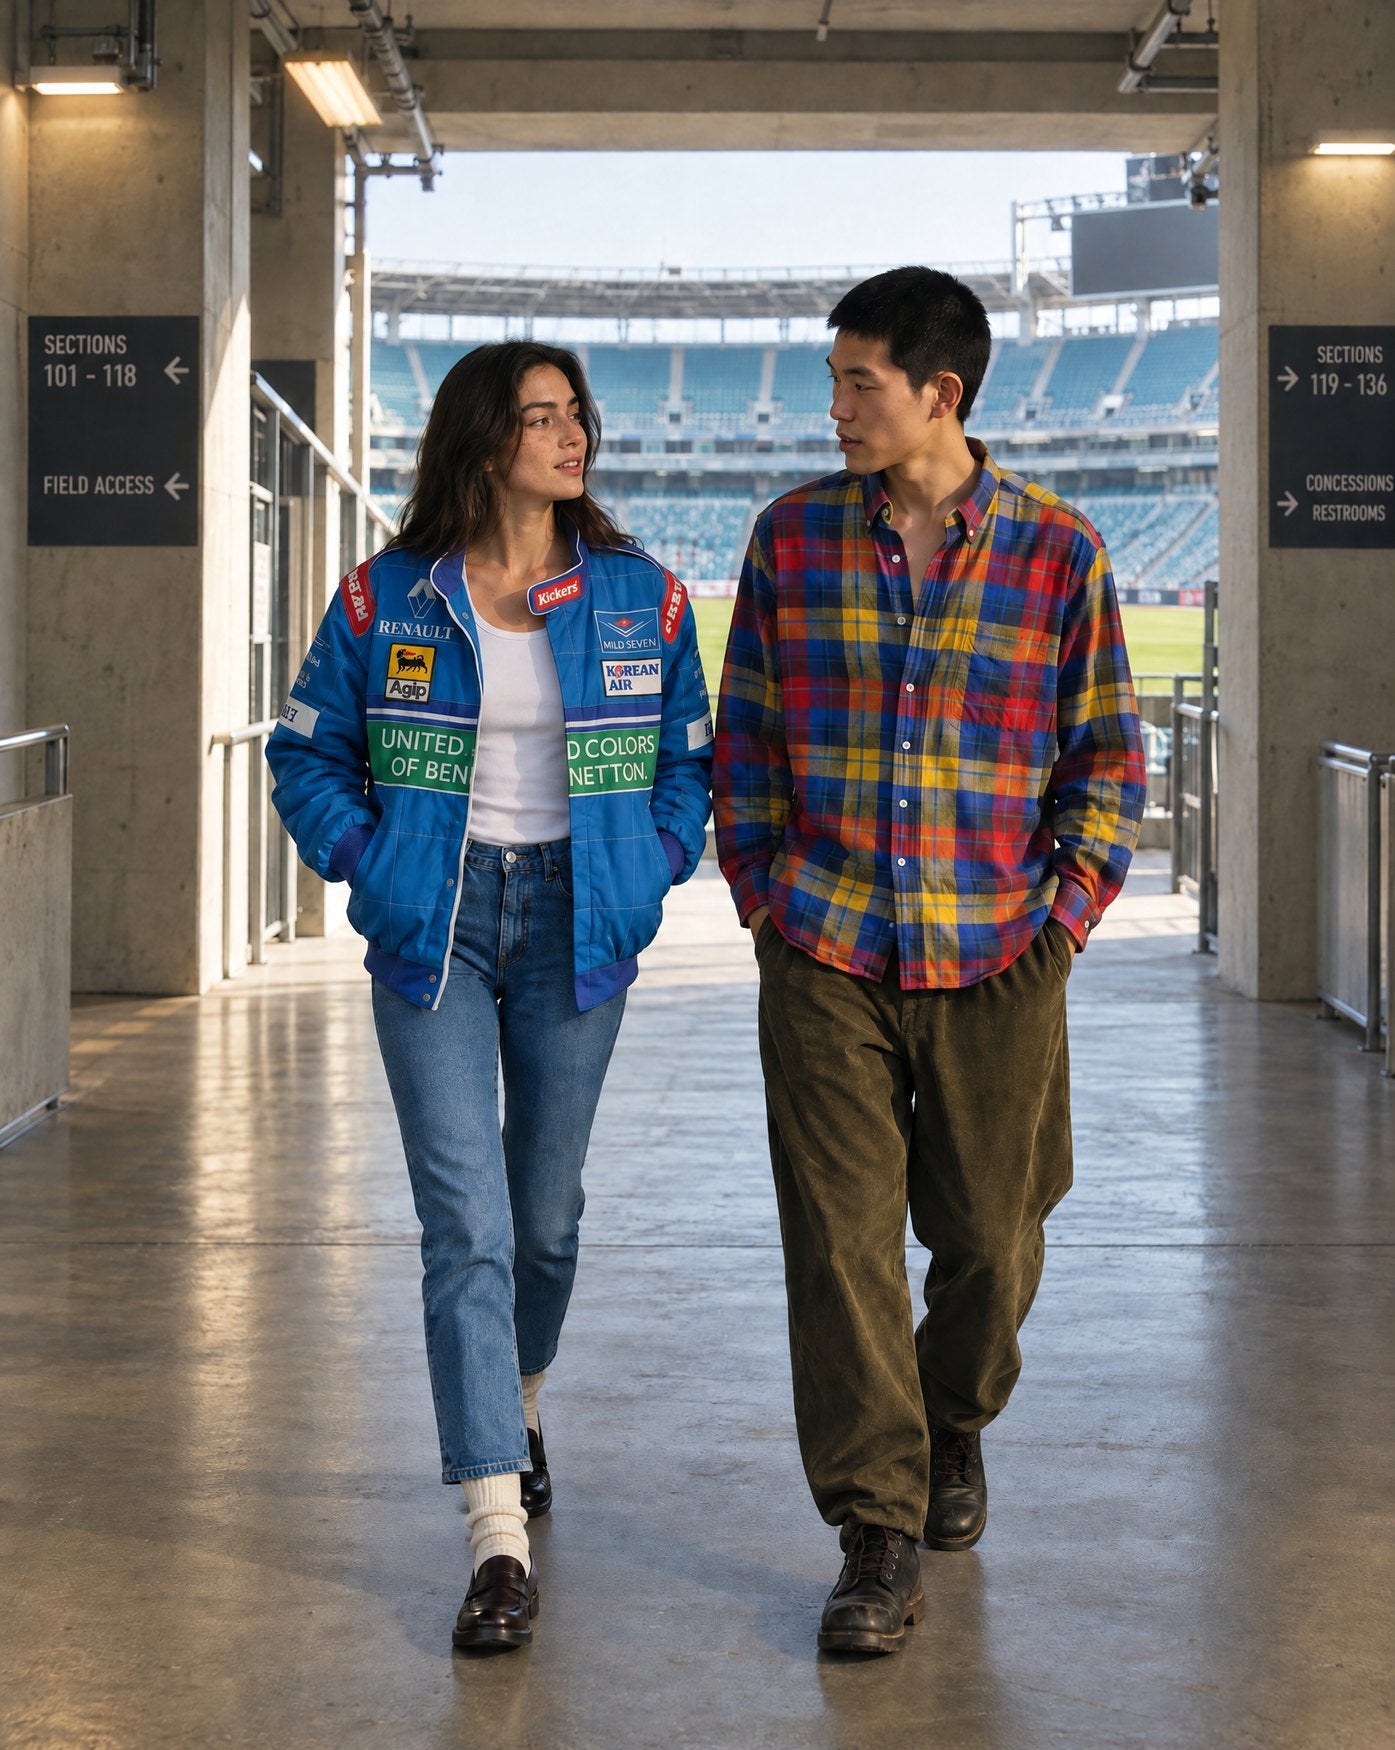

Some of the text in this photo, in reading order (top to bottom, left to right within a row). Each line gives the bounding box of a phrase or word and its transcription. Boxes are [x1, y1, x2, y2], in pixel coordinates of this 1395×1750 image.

[44, 335, 127, 354] SECTIONS
[1317, 346, 1383, 363] SECTIONS
[44, 364, 77, 387] 101
[103, 364, 137, 387] 118
[1311, 373, 1339, 395] 119
[1357, 373, 1387, 395] 136
[44, 475, 154, 494] FIELD ACCESS
[1306, 474, 1394, 492] CONCESSIONS
[1313, 504, 1386, 521] RESTROOMS
[538, 583, 578, 606] Kickers
[378, 620, 454, 640] RENAULT
[603, 638, 656, 649] MILD SEVEN
[606, 663, 659, 678] KOREAN
[389, 680, 427, 700] Agip
[609, 679, 633, 691] AIR
[585, 735, 655, 758] COLORS
[391, 757, 475, 785] OF BEN
